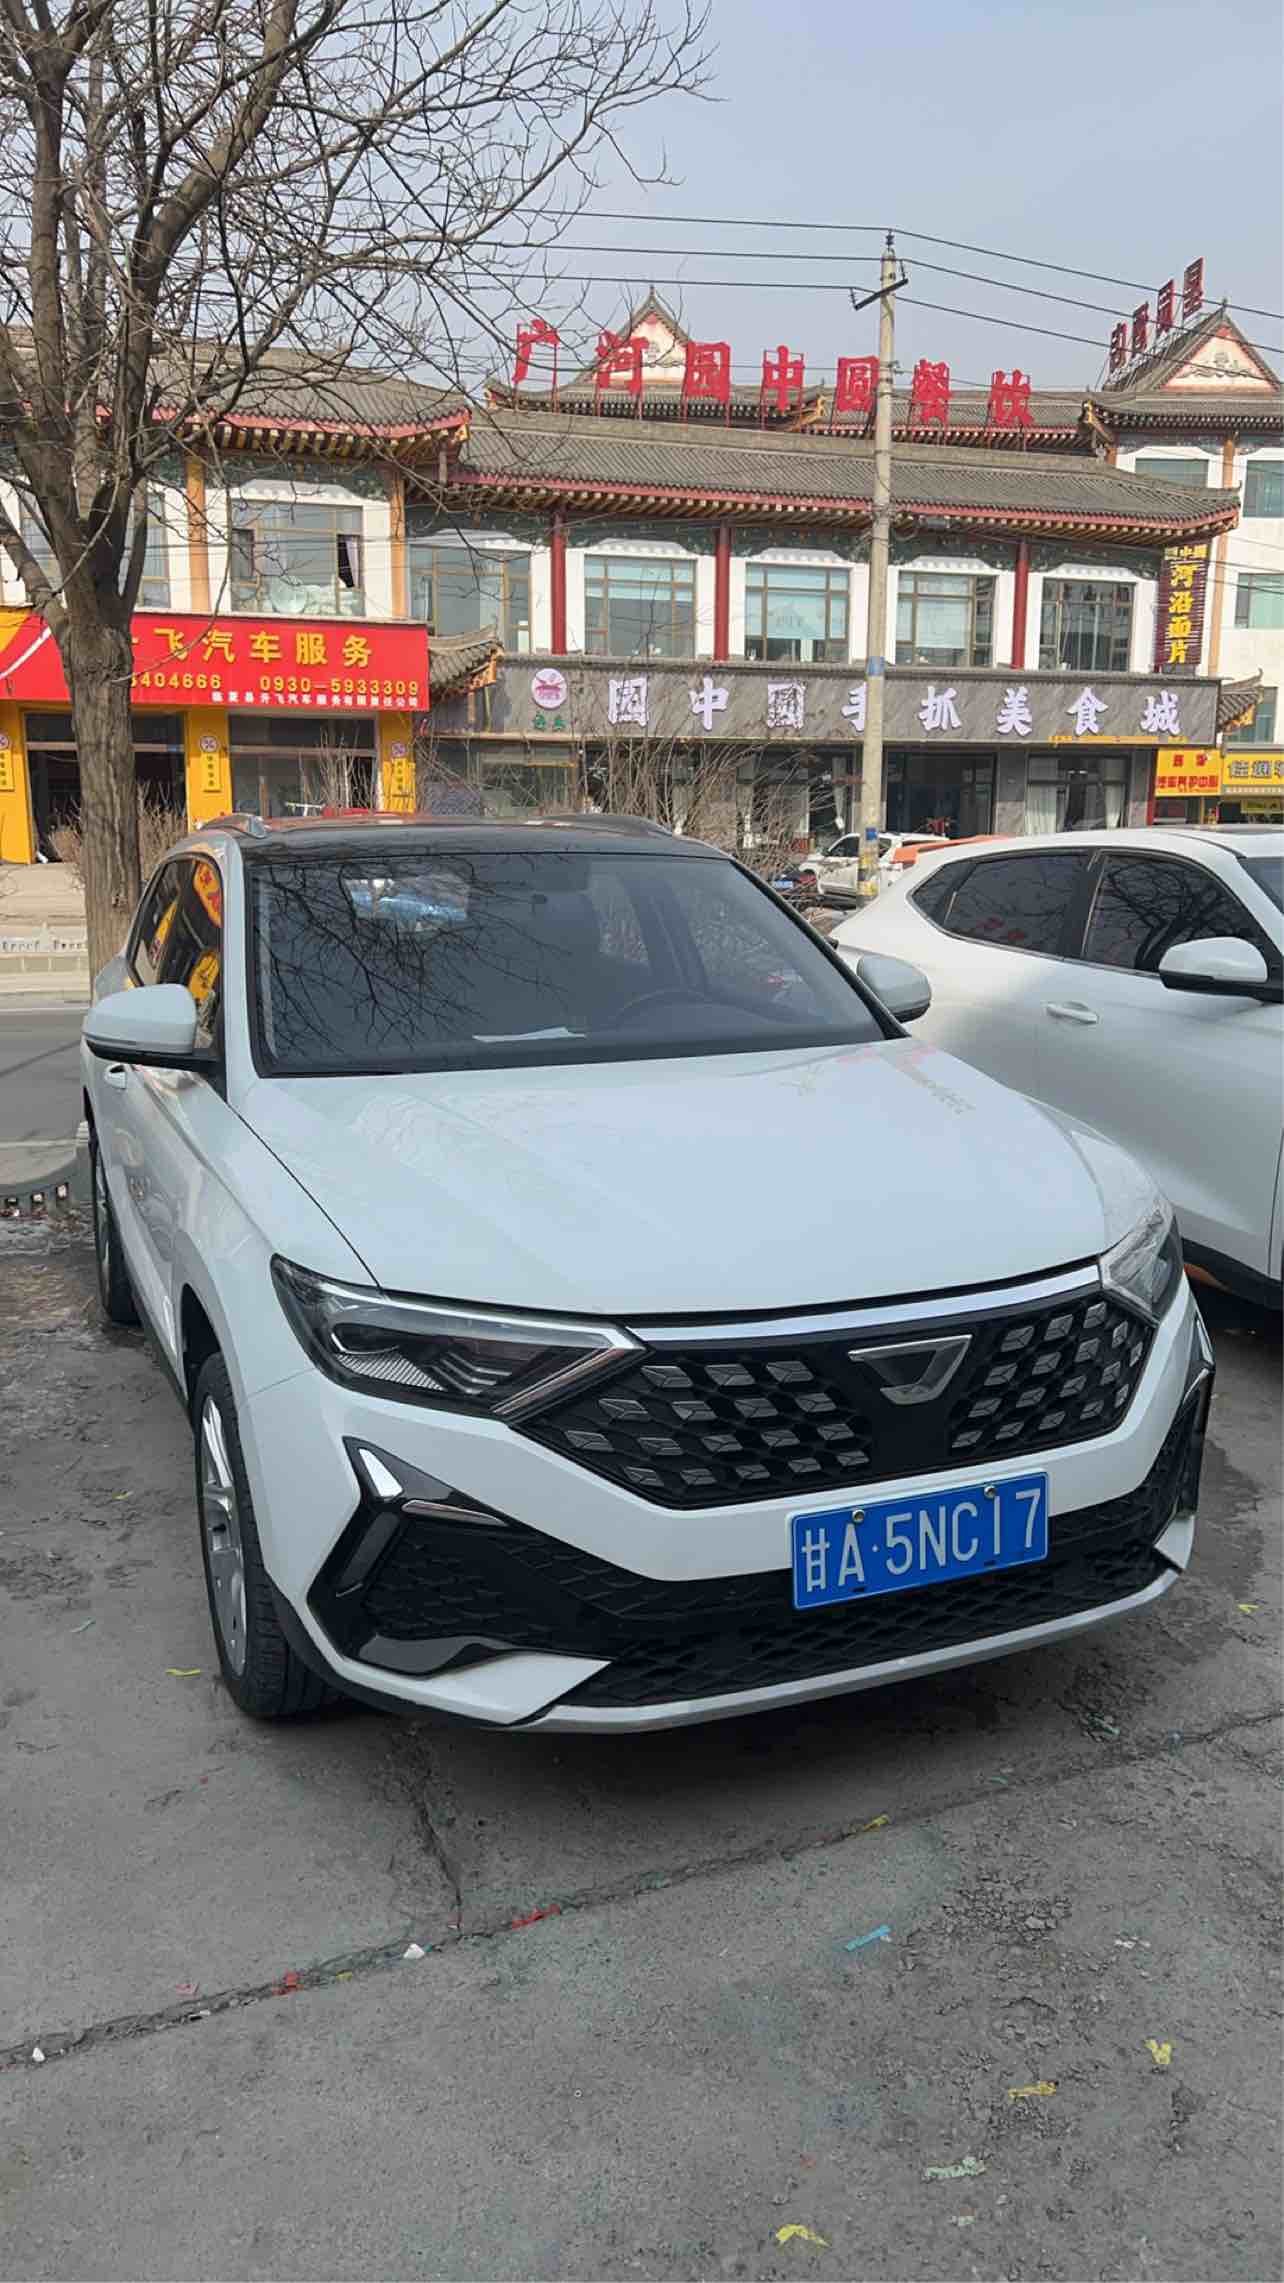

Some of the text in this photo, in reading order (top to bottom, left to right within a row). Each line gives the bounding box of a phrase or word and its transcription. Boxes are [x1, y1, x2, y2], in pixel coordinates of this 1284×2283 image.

[131, 627, 372, 667] 飞汽车服务
